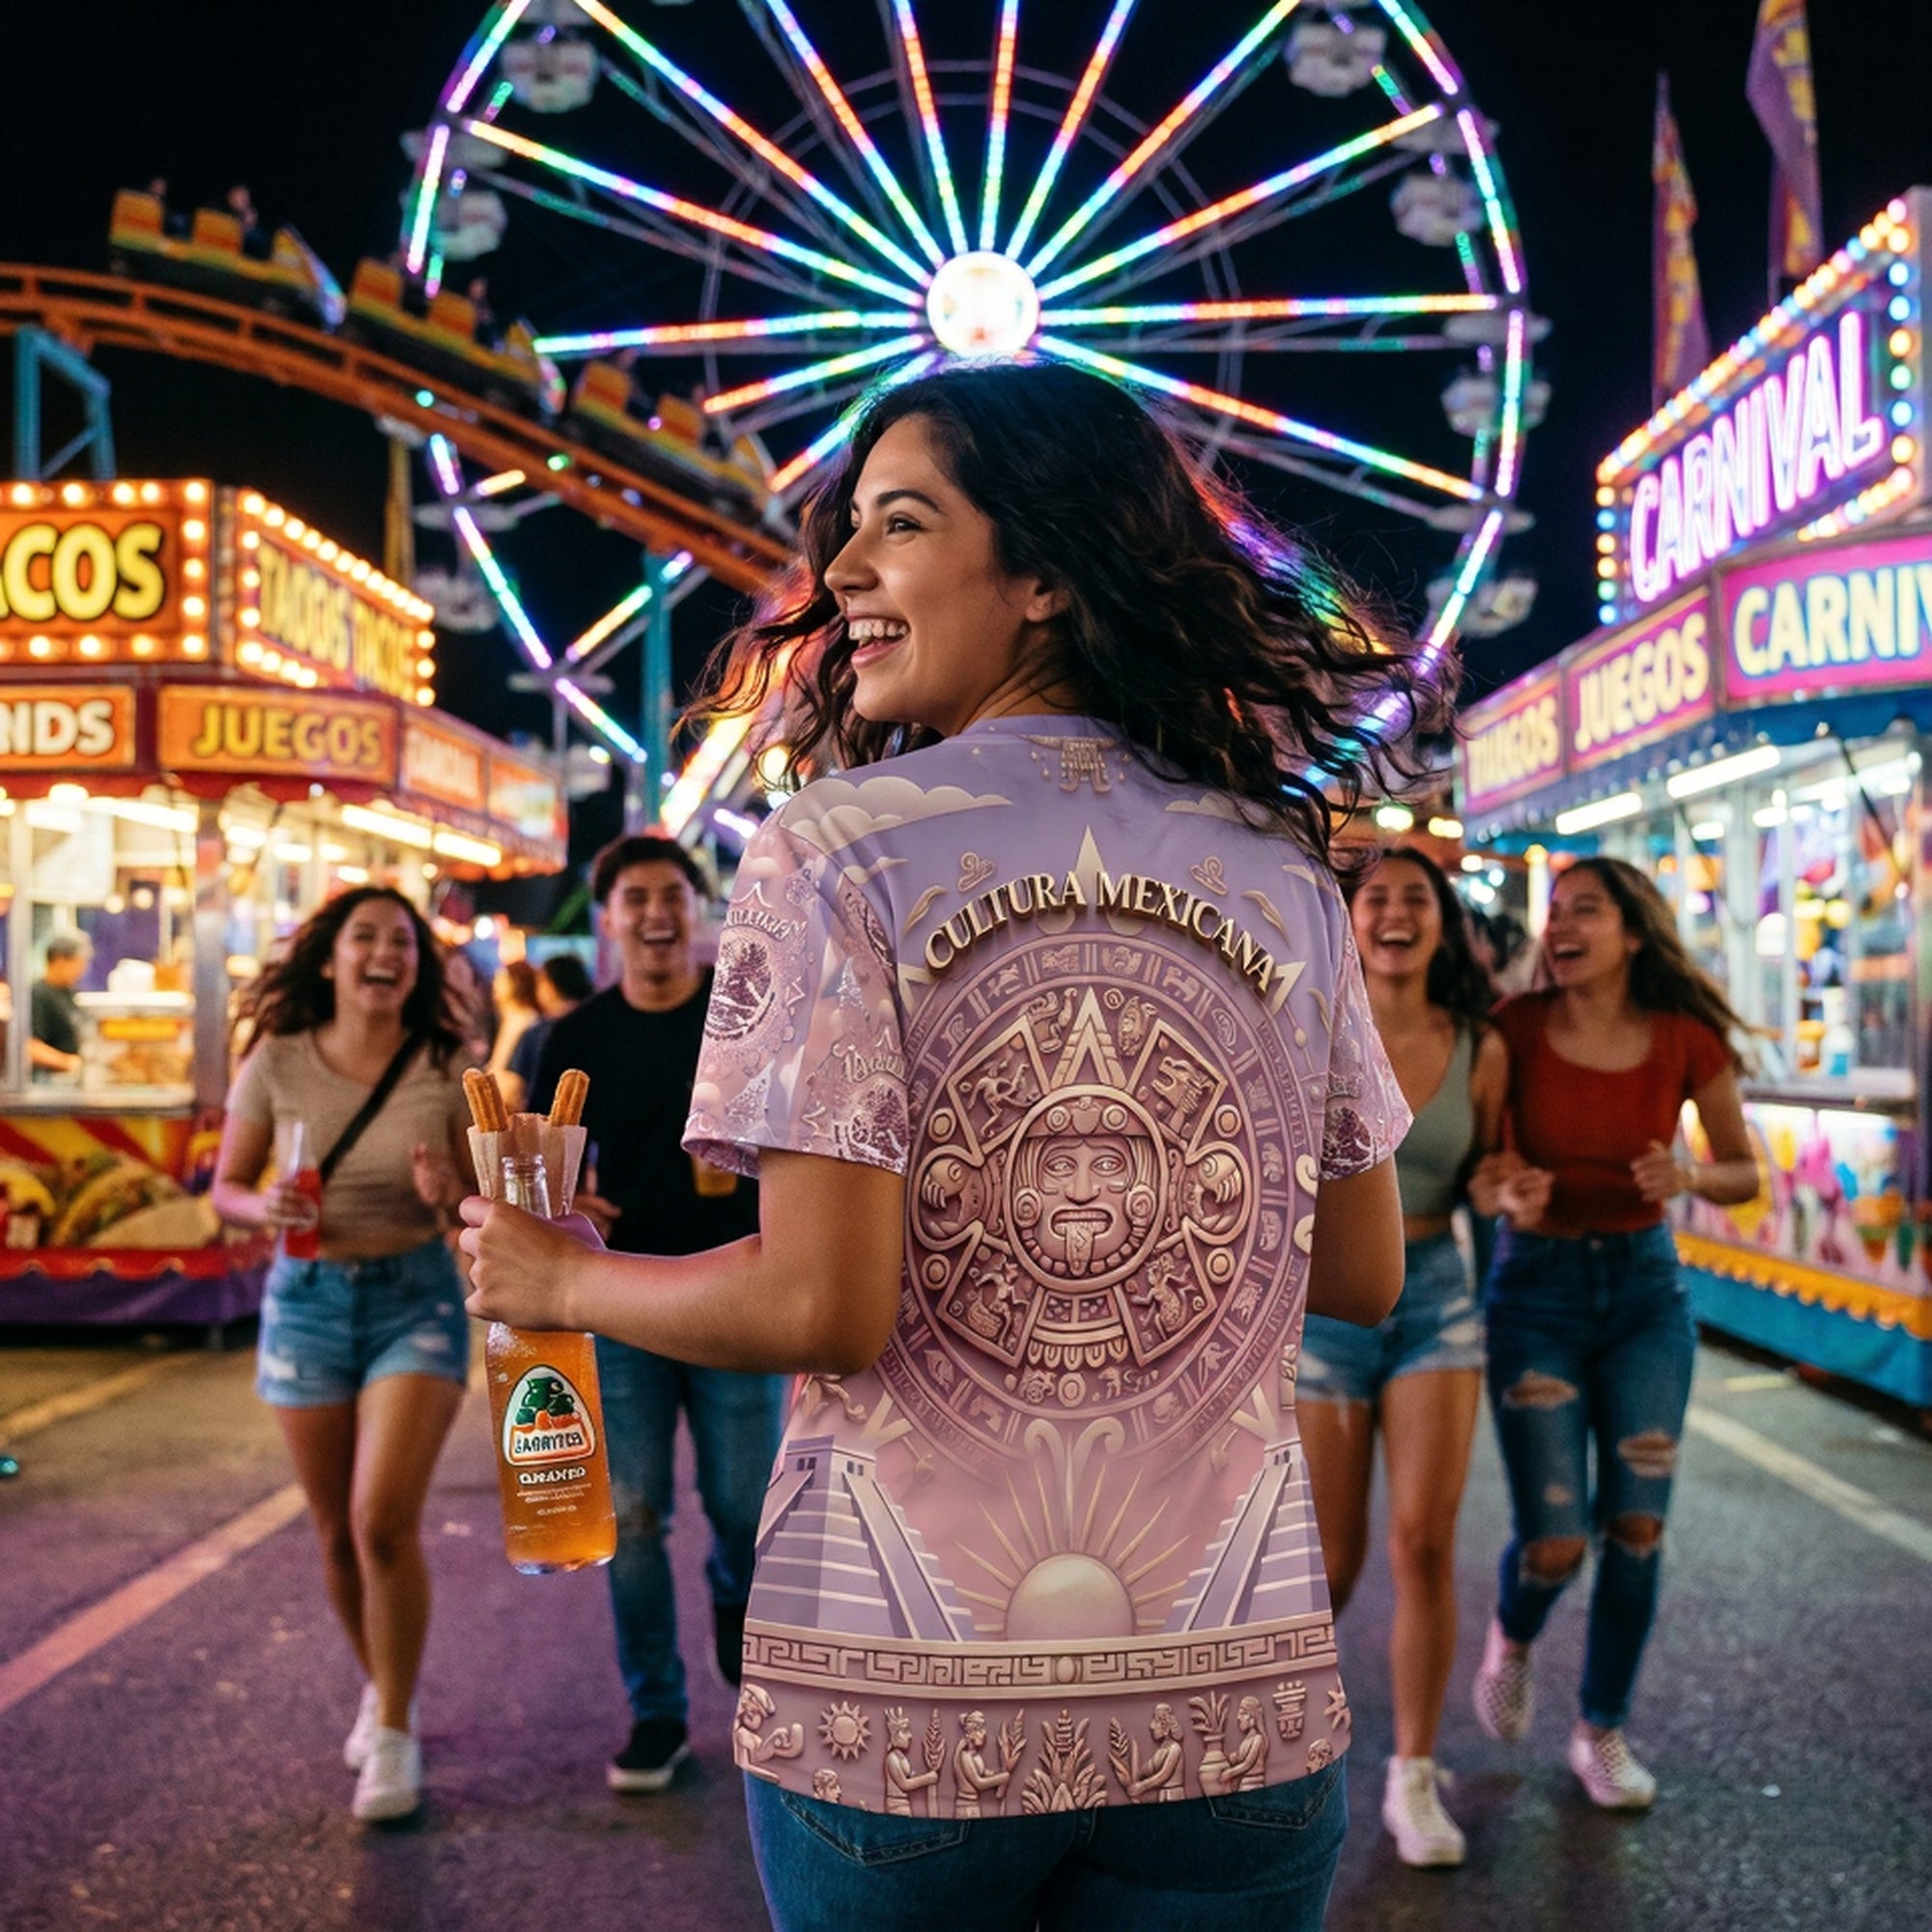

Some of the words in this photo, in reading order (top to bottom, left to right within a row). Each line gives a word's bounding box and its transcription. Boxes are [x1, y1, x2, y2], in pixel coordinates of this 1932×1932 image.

[1629, 311, 1883, 602] CARNIVAL
[0, 523, 164, 622] COS
[194, 702, 382, 766] JUEGOS
[1575, 612, 1710, 753] JUEGOS
[924, 870, 1089, 971] CULTURA
[1096, 870, 1276, 995] MEXICANA
